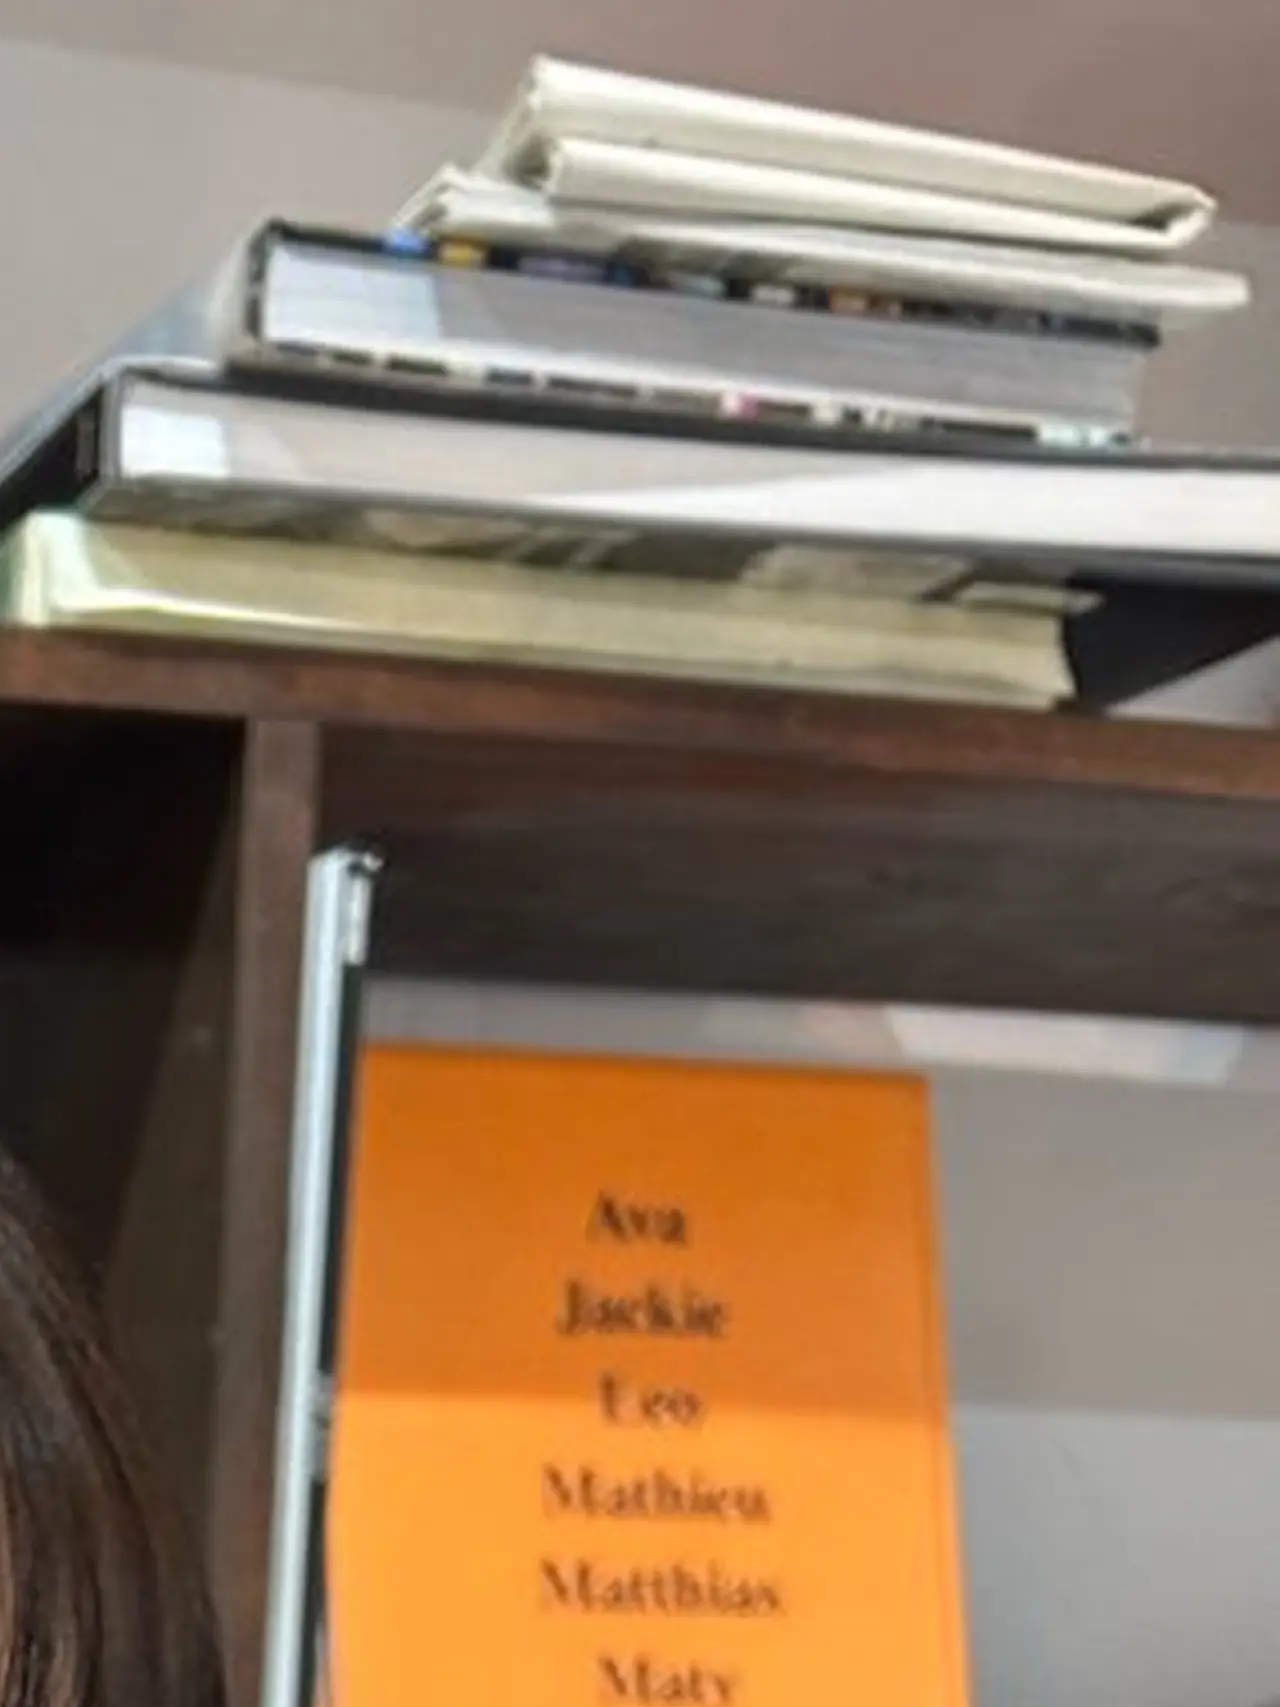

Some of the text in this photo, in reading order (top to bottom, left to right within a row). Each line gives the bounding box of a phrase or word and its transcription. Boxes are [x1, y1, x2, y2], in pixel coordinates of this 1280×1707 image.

[588, 1191, 688, 1245] Ava
[555, 1281, 728, 1337] Jackie
[600, 1376, 701, 1424] Leo
[542, 1466, 771, 1522] Mathieu
[540, 1560, 784, 1617] Matthias
